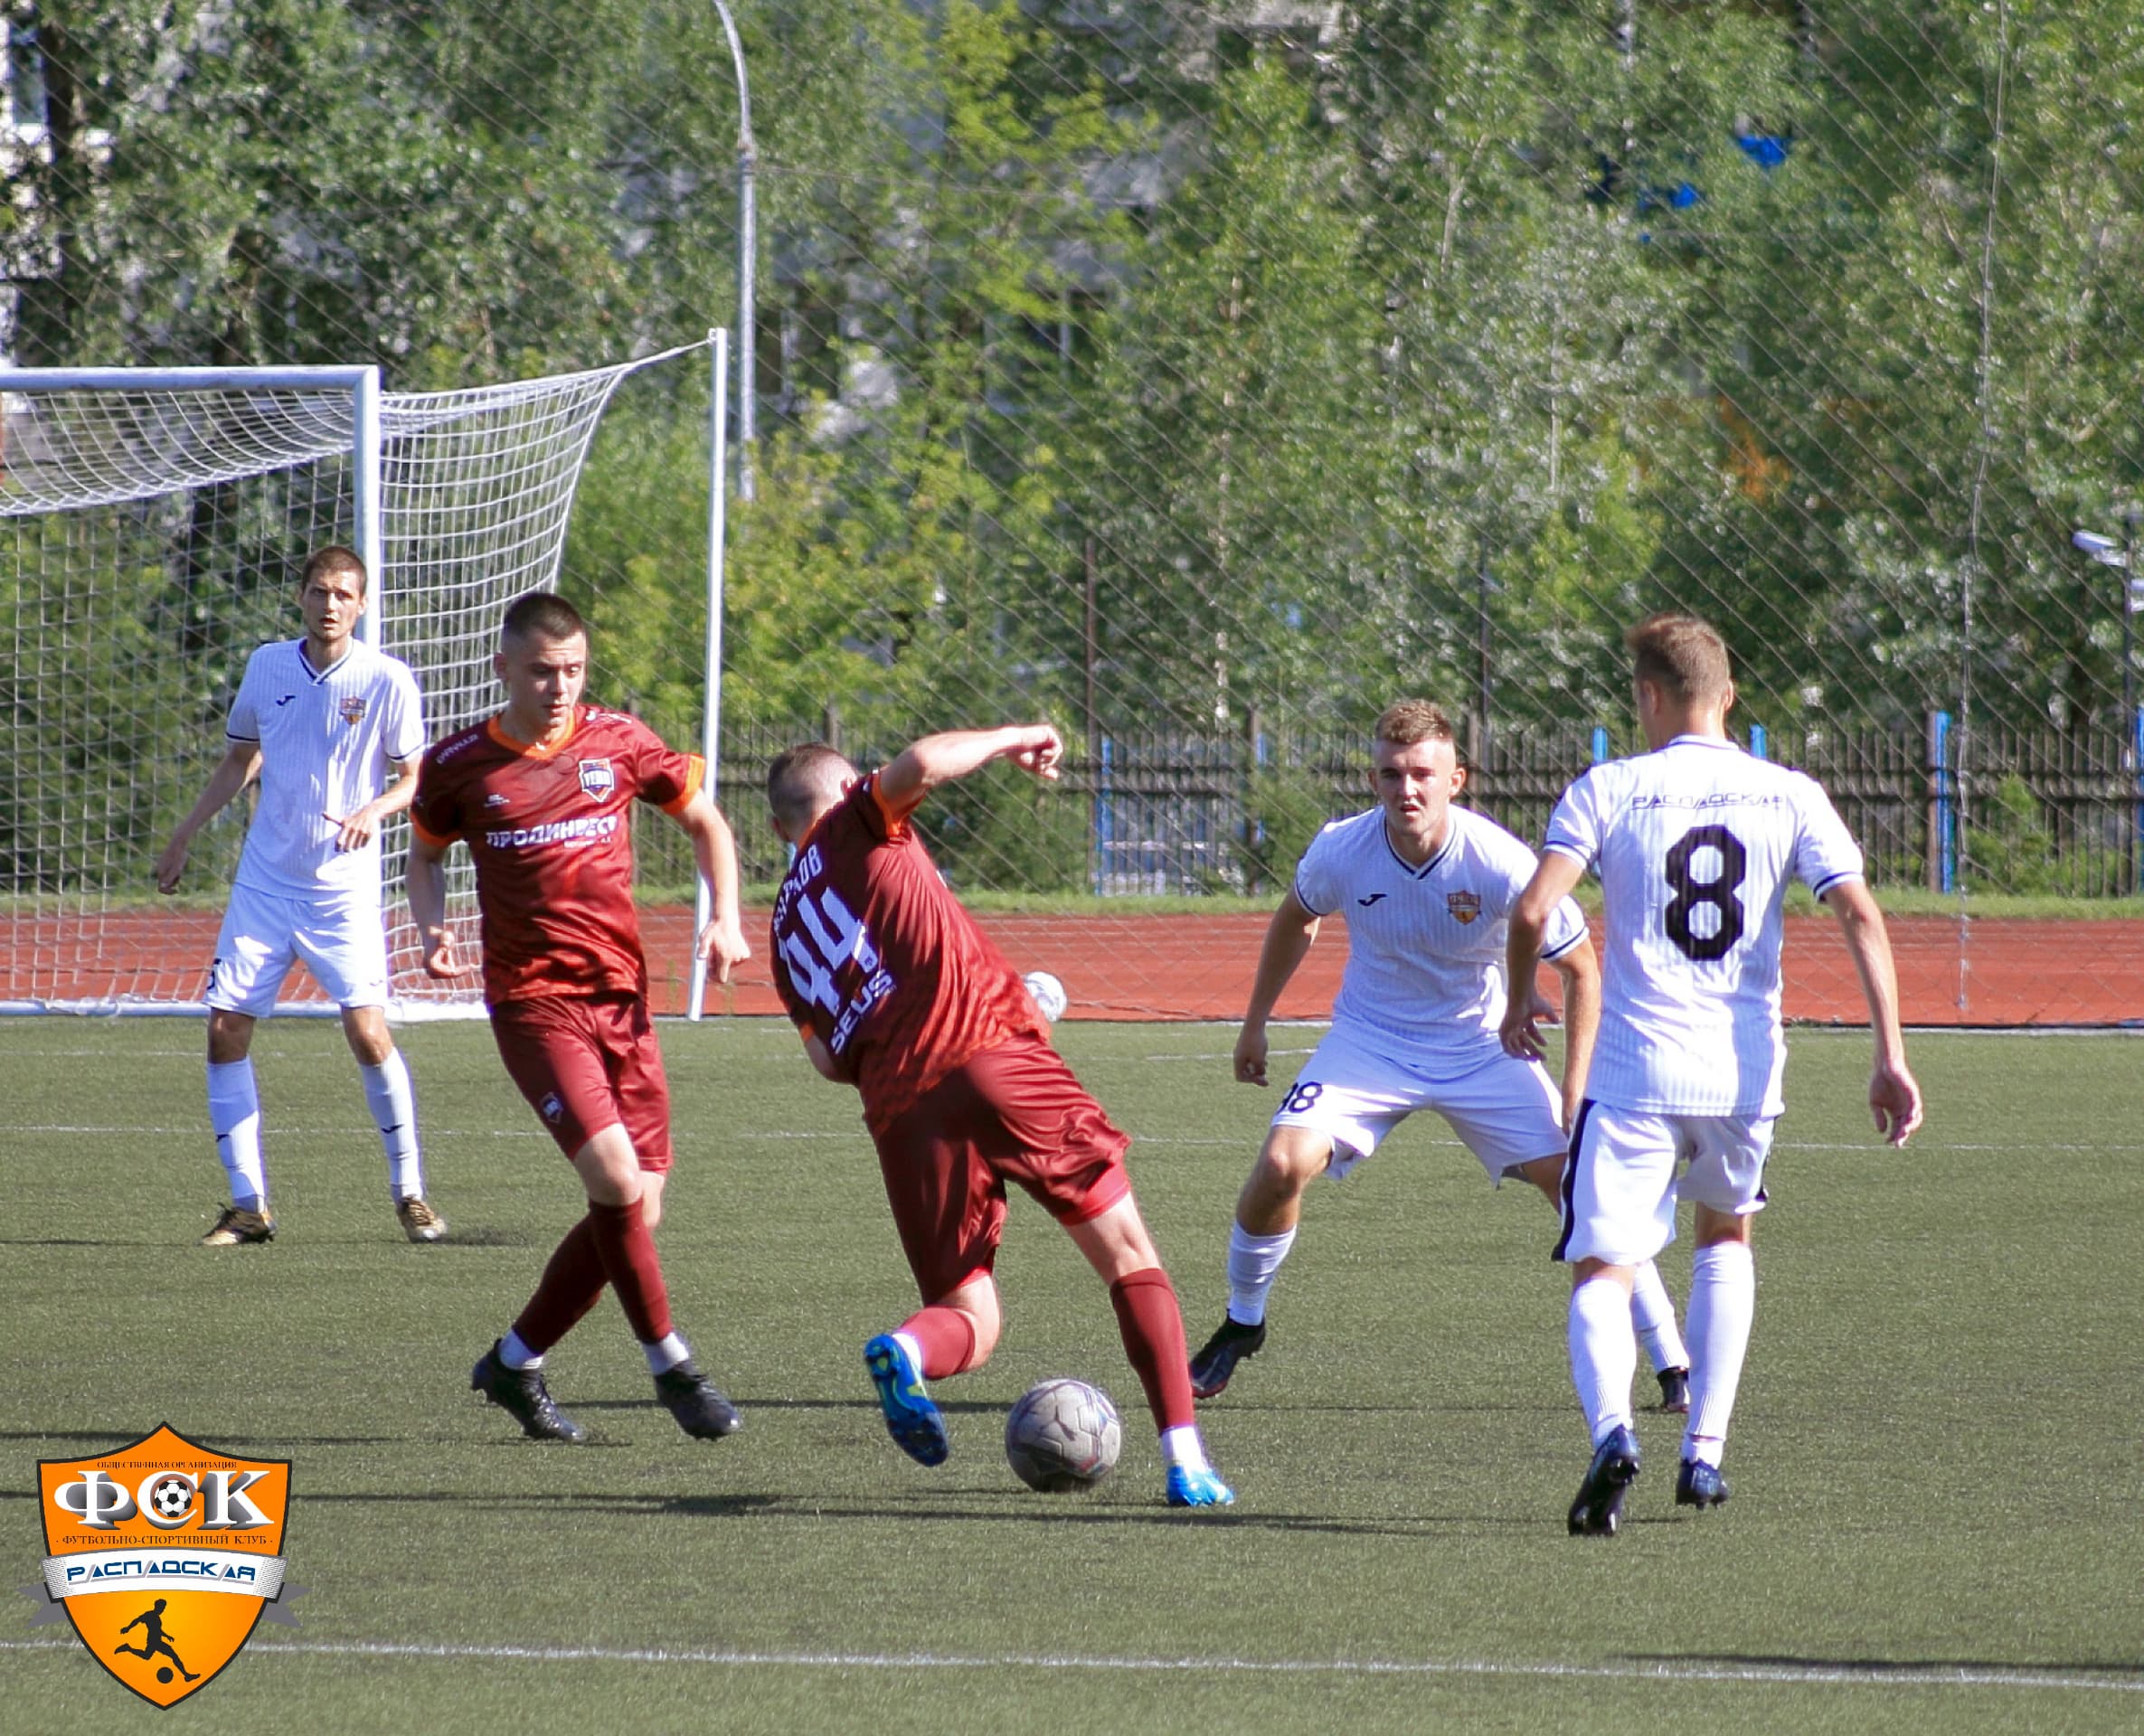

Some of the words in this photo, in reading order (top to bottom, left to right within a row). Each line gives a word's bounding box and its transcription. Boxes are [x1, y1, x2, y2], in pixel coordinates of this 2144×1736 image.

[778, 886, 878, 1018] 44
[1665, 824, 1747, 961] 8
[830, 968, 893, 1054] SEUS
